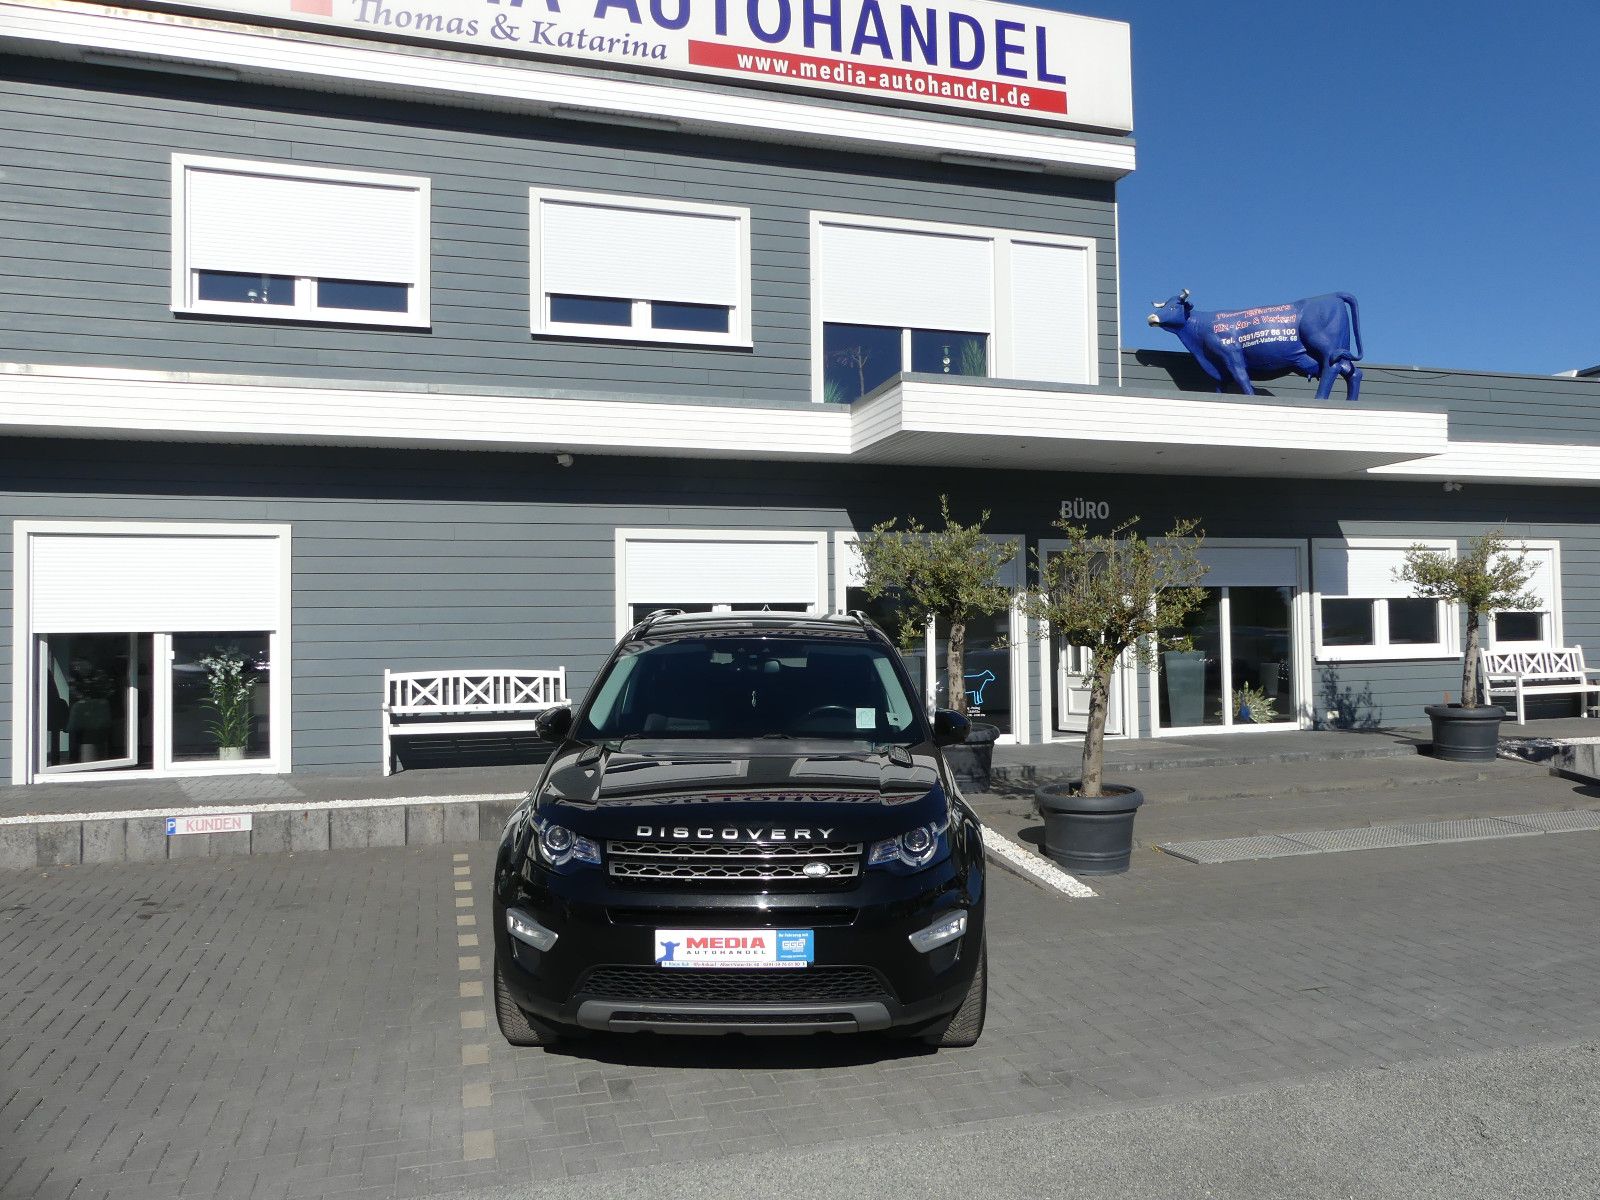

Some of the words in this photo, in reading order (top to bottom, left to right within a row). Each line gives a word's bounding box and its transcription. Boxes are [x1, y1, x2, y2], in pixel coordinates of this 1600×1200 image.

[353, 0, 479, 37] Thomas
[490, 13, 521, 41] &
[528, 20, 668, 60] Katarina
[737, 53, 1031, 107] www.media-autohandel.de
[1221, 337, 1236, 345] Tel.
[1238, 329, 1270, 343] 0391/597
[1283, 328, 1296, 336] 100
[1061, 498, 1110, 519] BÜRO
[167, 821, 175, 832] P
[186, 817, 242, 832] KUNDEN
[636, 825, 834, 840] DISCOVERY
[686, 937, 766, 949] MEDIA
